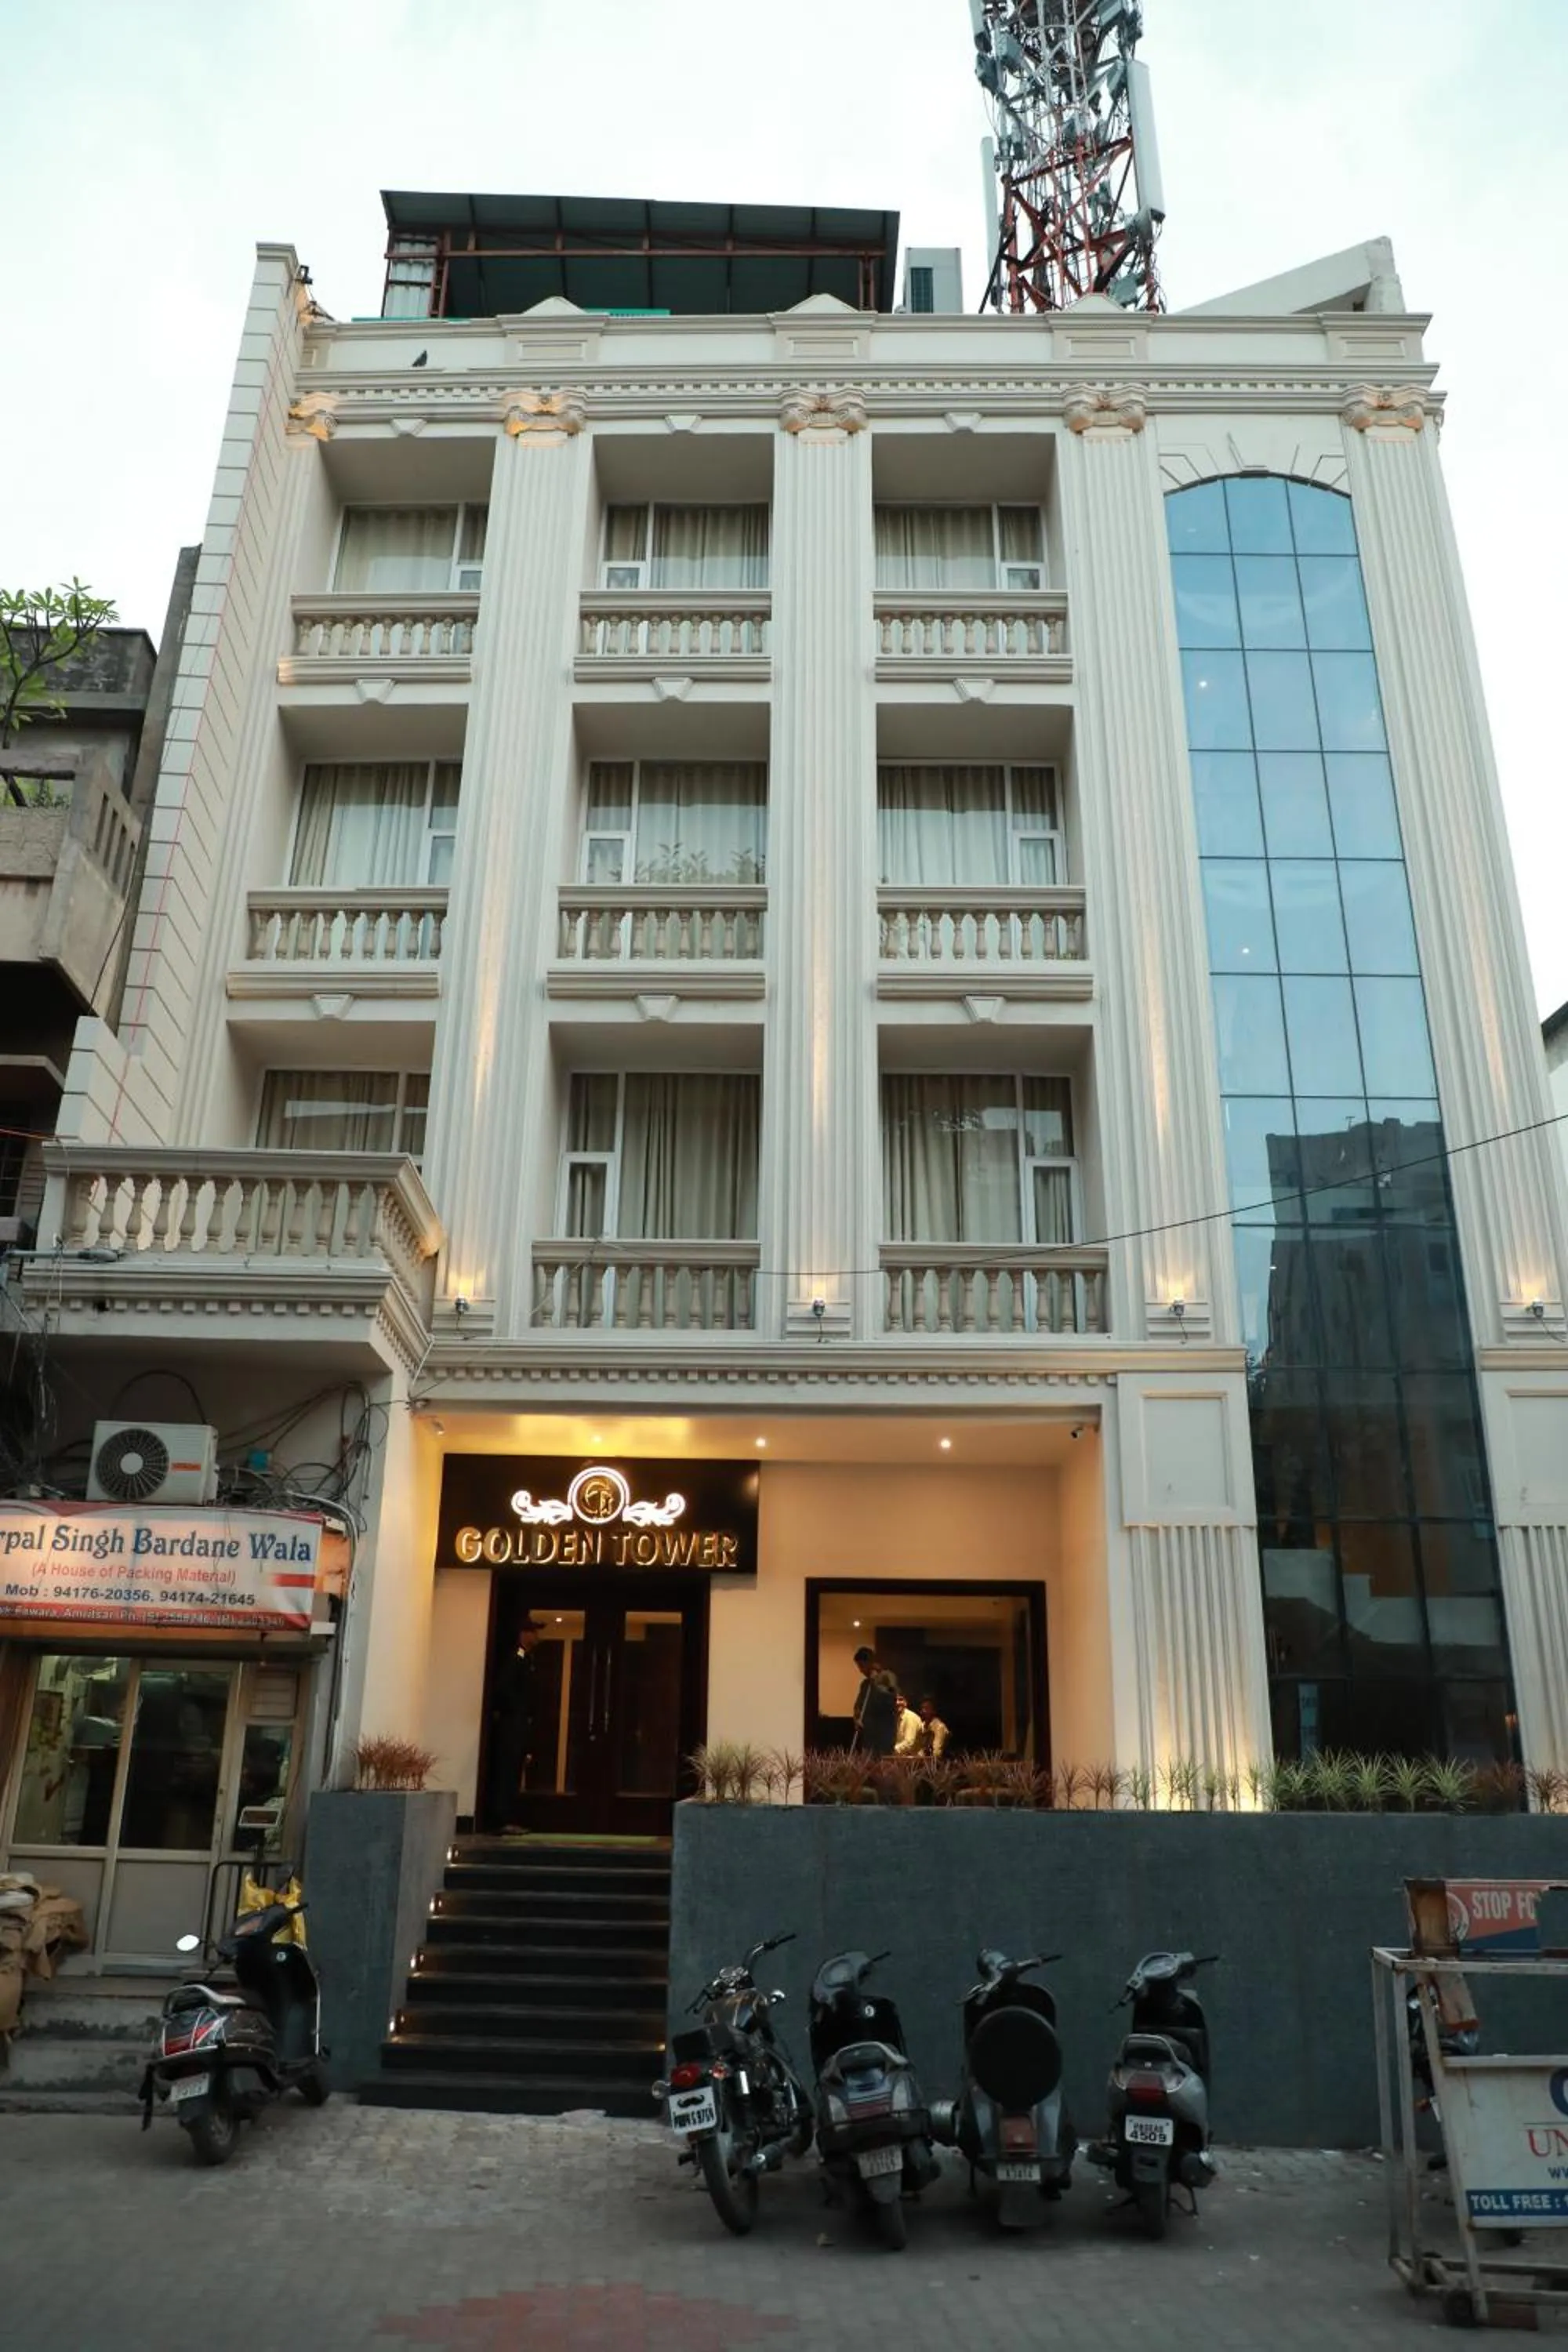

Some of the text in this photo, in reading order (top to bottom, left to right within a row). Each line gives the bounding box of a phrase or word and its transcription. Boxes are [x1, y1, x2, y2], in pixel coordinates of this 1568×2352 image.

[52, 1524, 124, 1559] Singh
[134, 1527, 239, 1558] Bardane
[249, 1533, 311, 1561] Wala
[455, 1526, 740, 1567] GOLDEN TOWER
[52, 1563, 96, 1577] House
[100, 1565, 114, 1578] of
[118, 1566, 172, 1584] Packing
[176, 1568, 236, 1587] Material)
[5, 1583, 39, 1596] Mob
[160, 1589, 255, 1606] 94174-21645
[1472, 1890, 1512, 1920] STOP
[1130, 2130, 1167, 2143] 4509
[1471, 2195, 1510, 2210] TOLL
[1512, 2195, 1552, 2209] FREE
